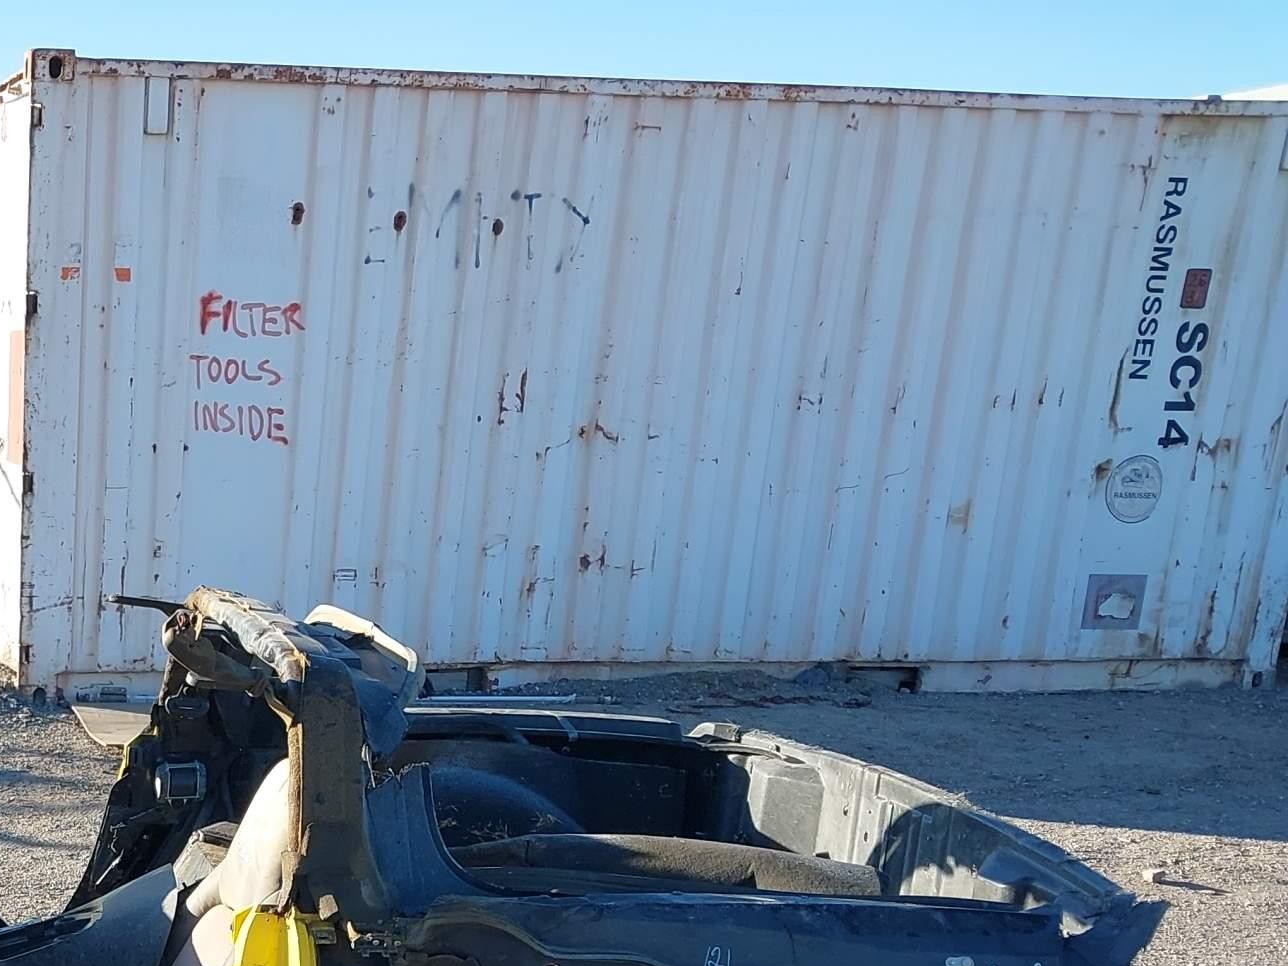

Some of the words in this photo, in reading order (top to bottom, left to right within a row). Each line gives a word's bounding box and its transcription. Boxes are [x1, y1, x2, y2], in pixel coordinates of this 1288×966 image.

[1128, 176, 1189, 380] RASMUSSEN
[200, 290, 306, 338] FILTER
[189, 354, 282, 390] TOOLS
[1157, 320, 1210, 449] SC14
[193, 399, 289, 445] INSIDE
[1113, 491, 1157, 500] RASMUSSEN
